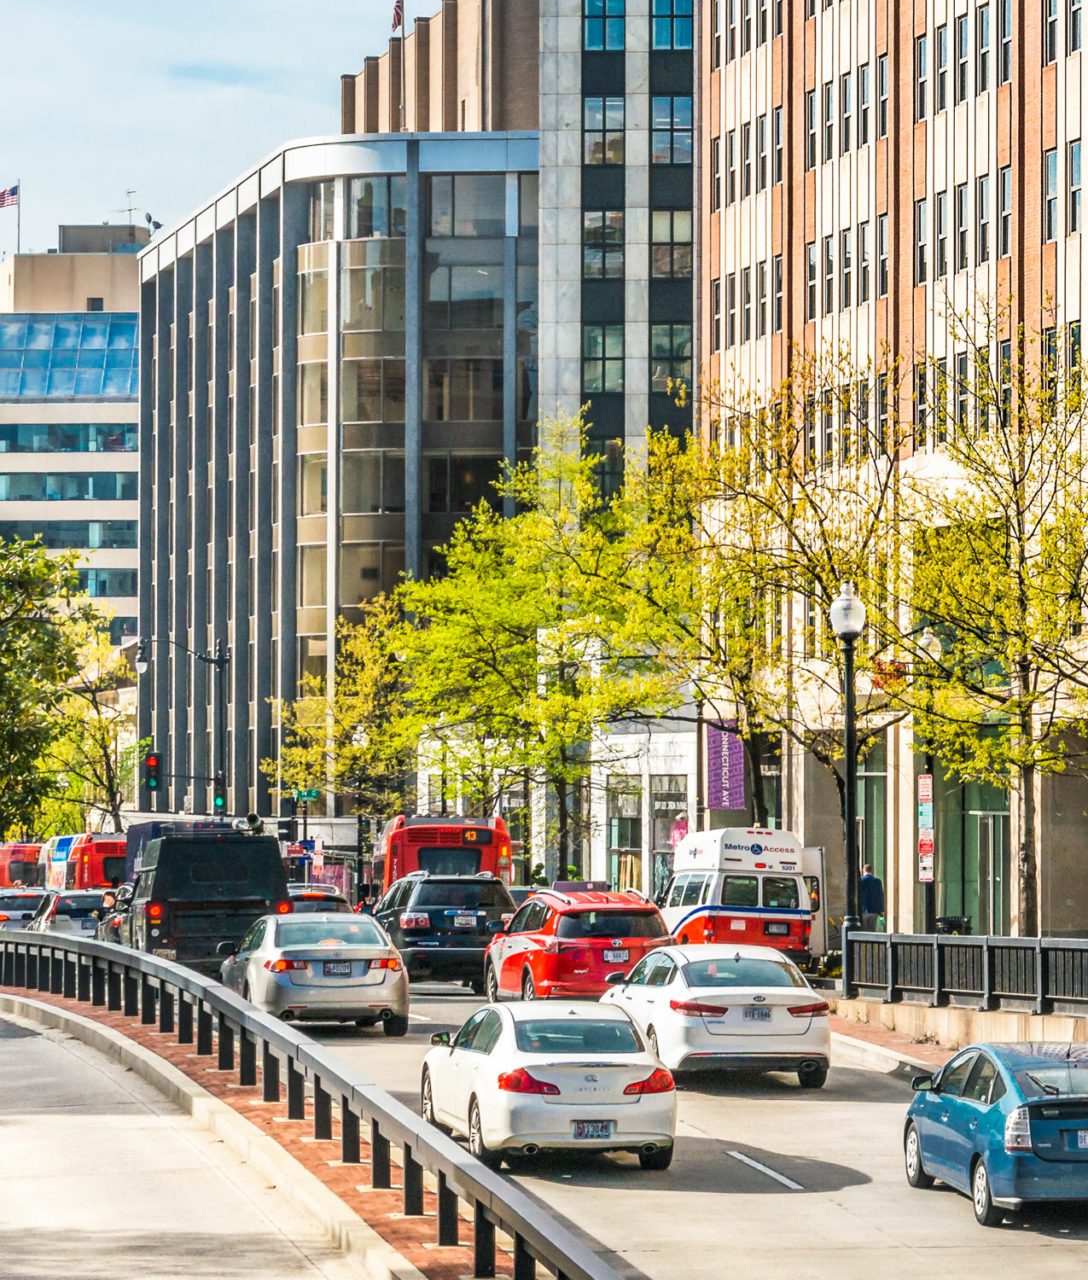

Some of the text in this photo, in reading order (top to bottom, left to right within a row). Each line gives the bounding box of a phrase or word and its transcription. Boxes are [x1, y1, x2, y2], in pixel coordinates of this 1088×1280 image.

[721, 790, 730, 807] AVE
[464, 830, 477, 841] 43
[724, 843, 796, 853] Metro Access
